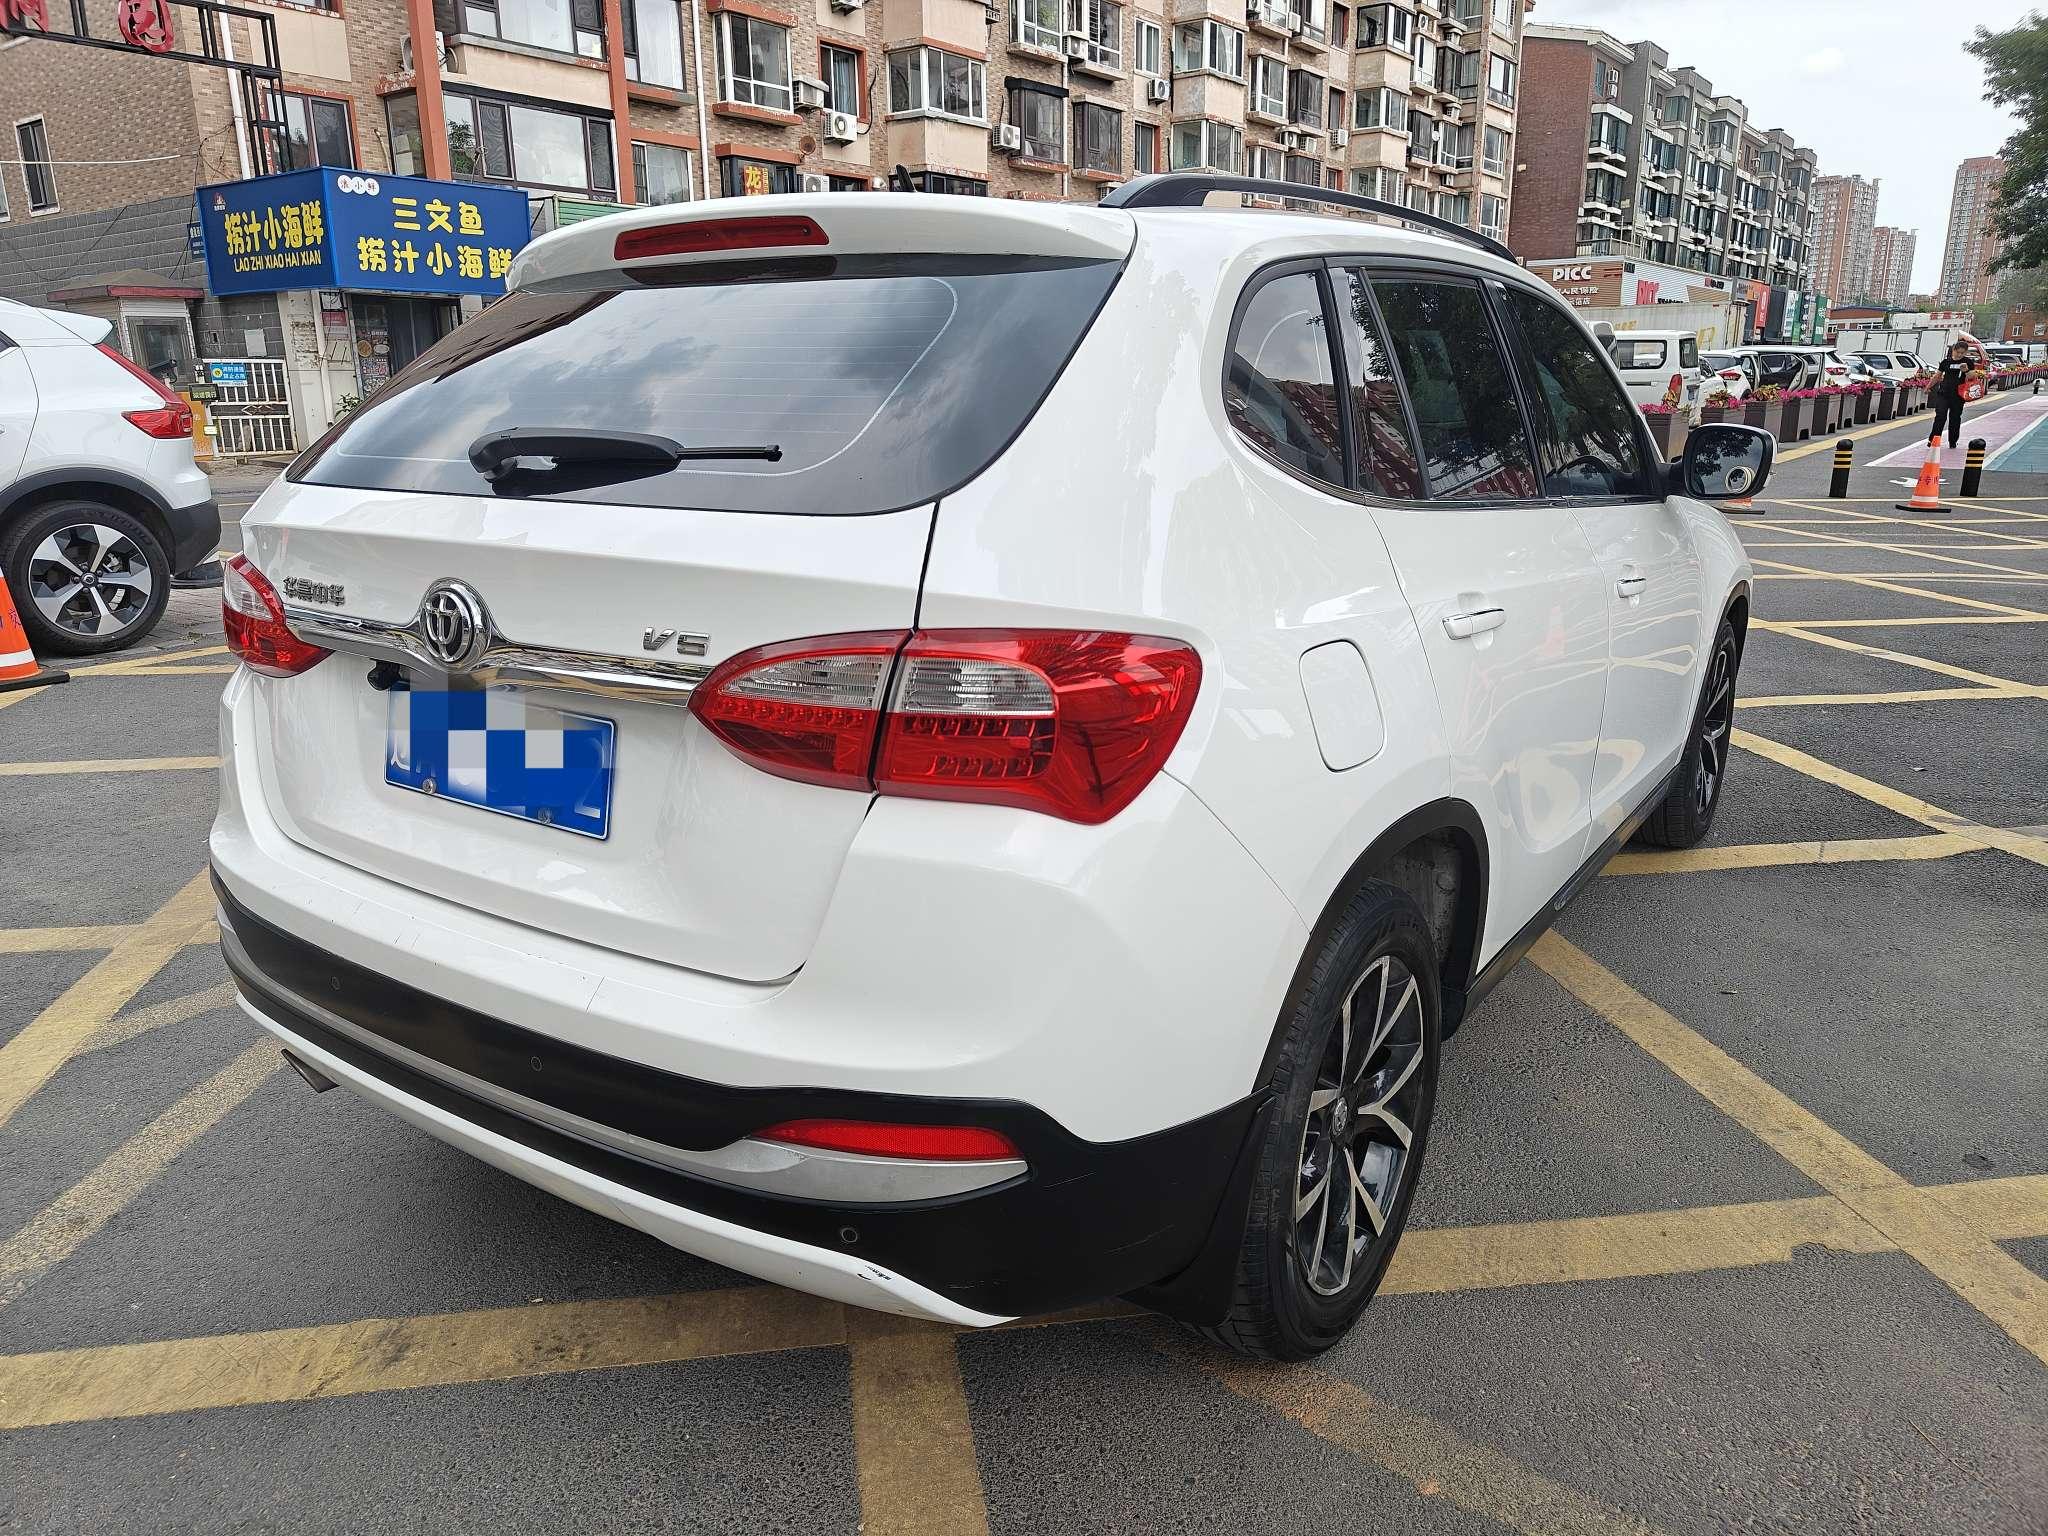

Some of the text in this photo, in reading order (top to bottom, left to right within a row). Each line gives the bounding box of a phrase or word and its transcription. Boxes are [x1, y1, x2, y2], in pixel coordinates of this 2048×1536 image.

[224, 199, 324, 256] 捞汁小海鲜
[392, 197, 485, 236] 三文鱼
[233, 249, 321, 273] LAO ZHI XIAO HAI XIAN
[356, 236, 513, 280] 捞汁小海鲜
[1553, 265, 1592, 281] PICC
[283, 576, 345, 607] 华晨中华
